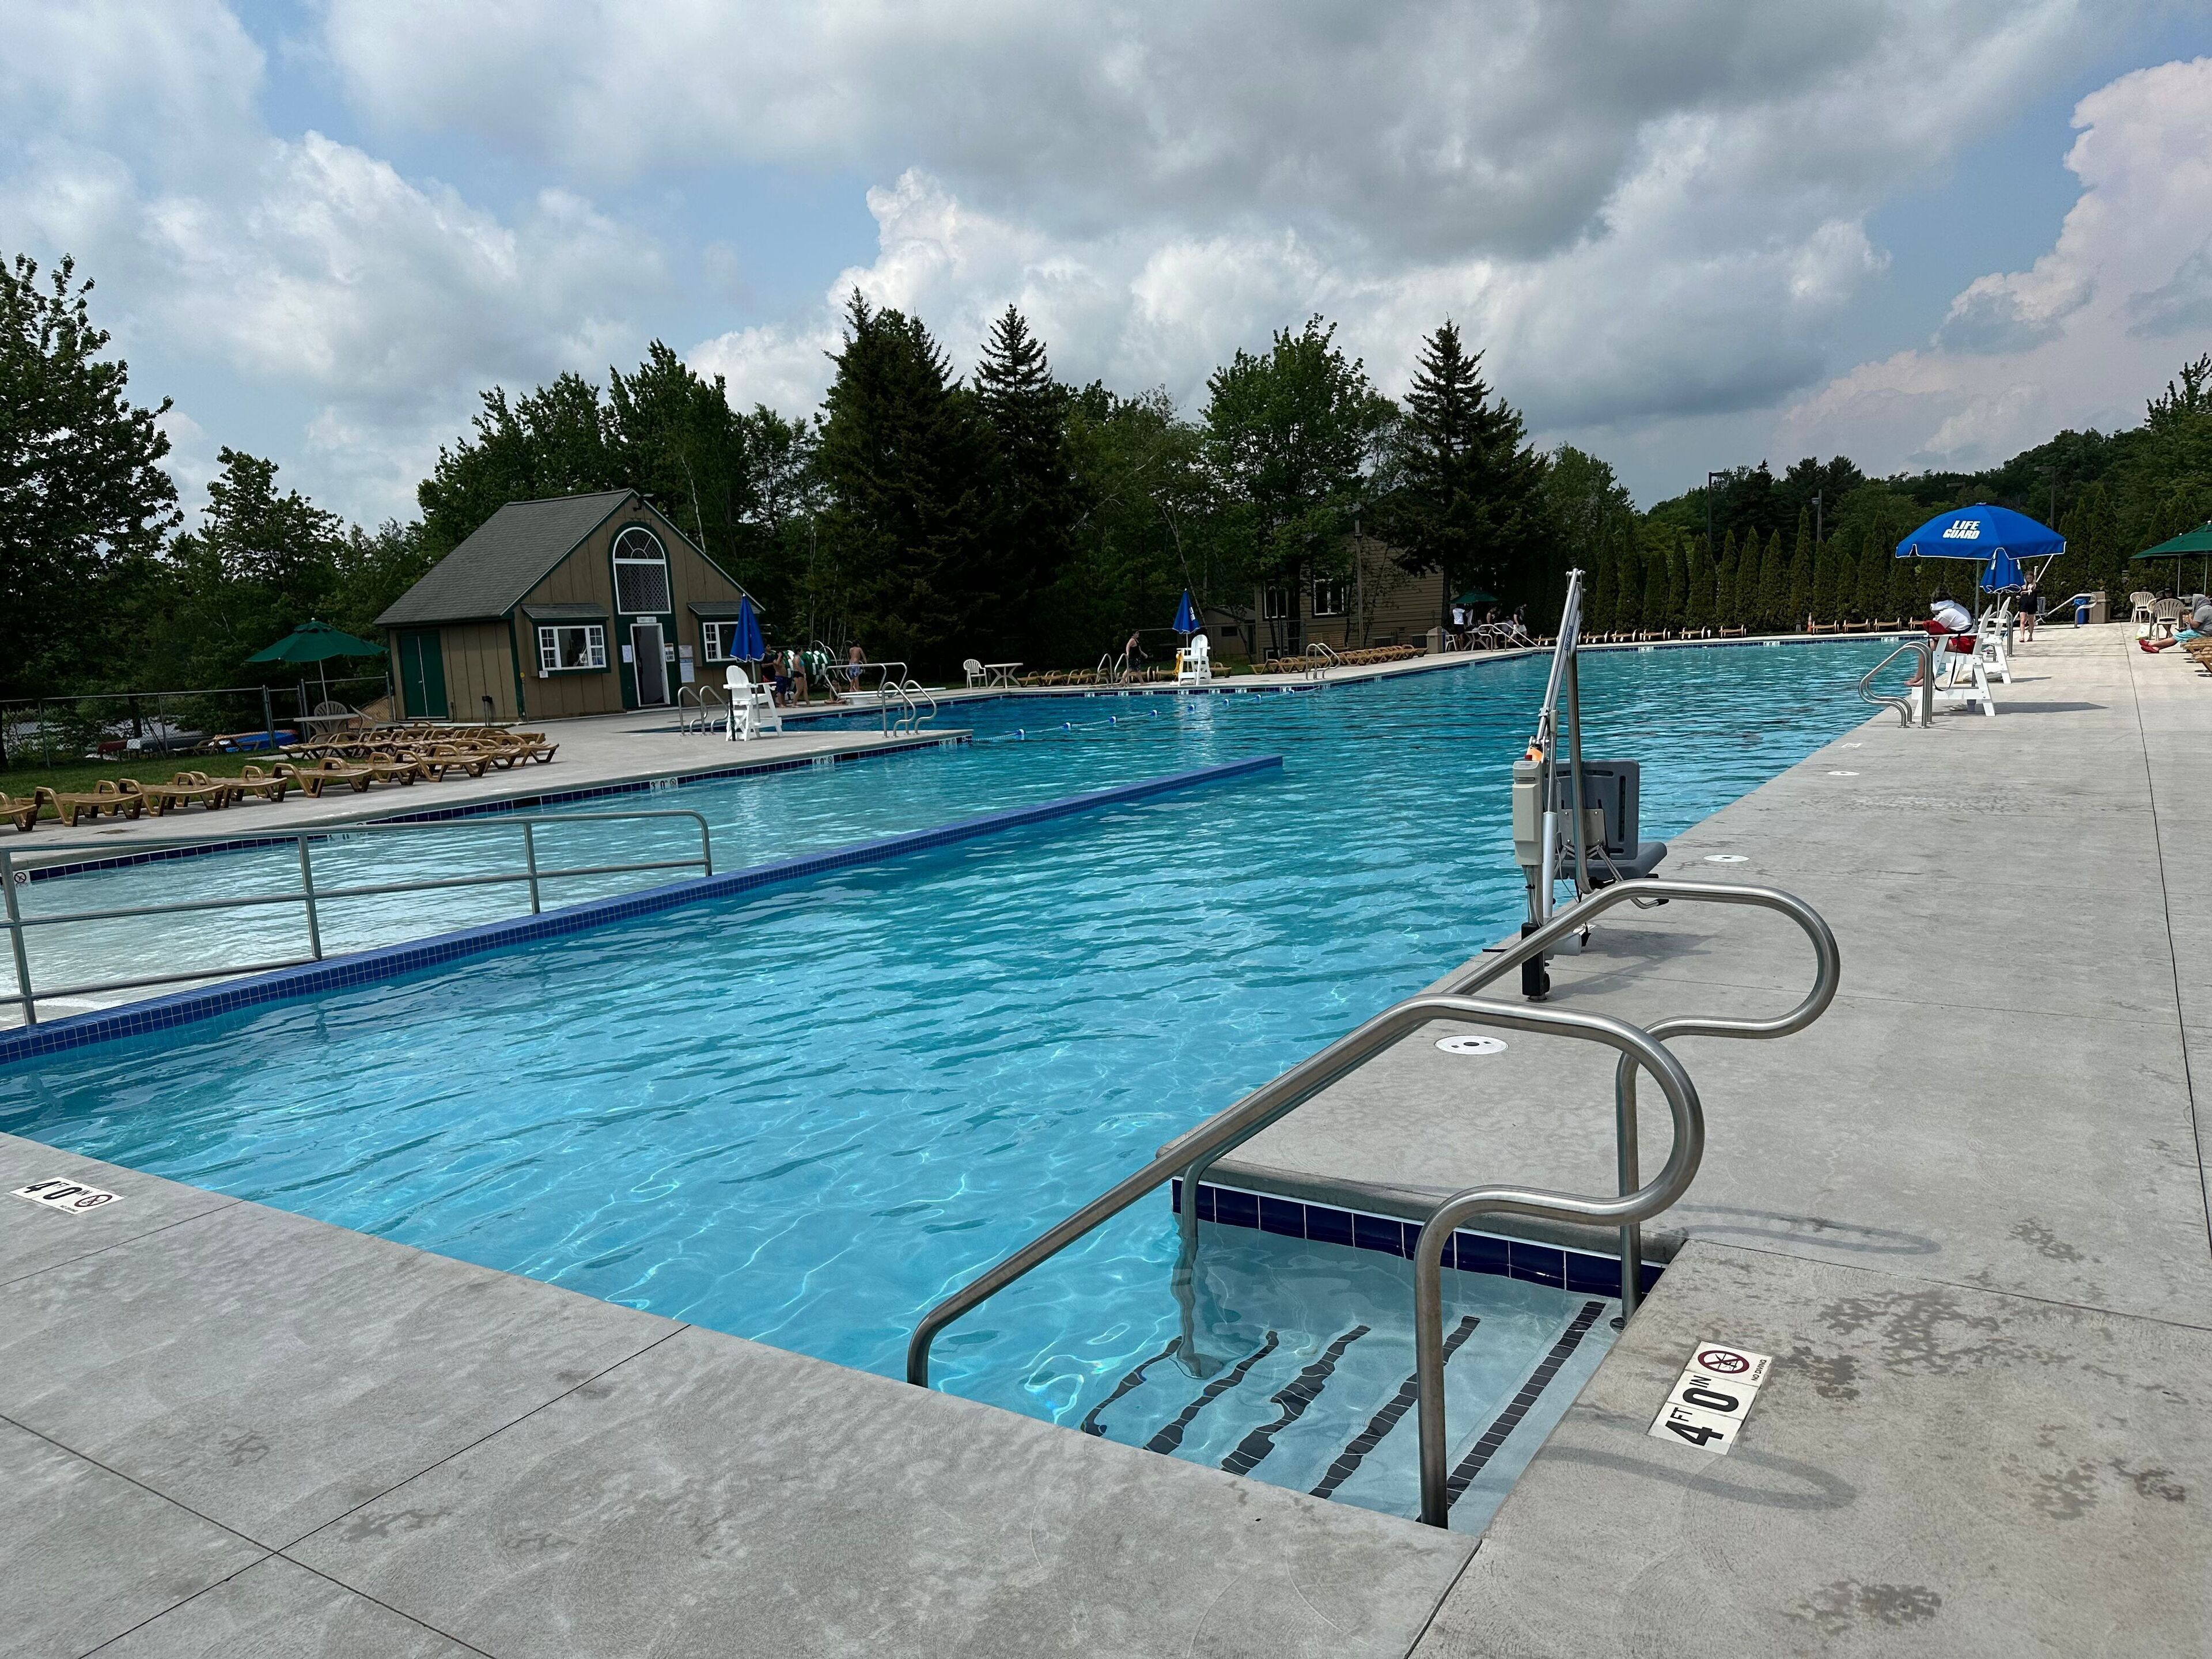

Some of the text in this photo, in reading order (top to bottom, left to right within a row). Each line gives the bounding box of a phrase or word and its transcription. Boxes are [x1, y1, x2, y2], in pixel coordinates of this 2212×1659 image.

[1952, 520, 1981, 531] LIFE
[1942, 529, 1980, 540] GUARD
[23, 1180, 61, 1194] 4
[43, 1187, 83, 1200] 0
[1755, 1359, 1767, 1374] DIVING
[1682, 1387, 1739, 1412] 0
[1665, 1420, 1724, 1446] 4
